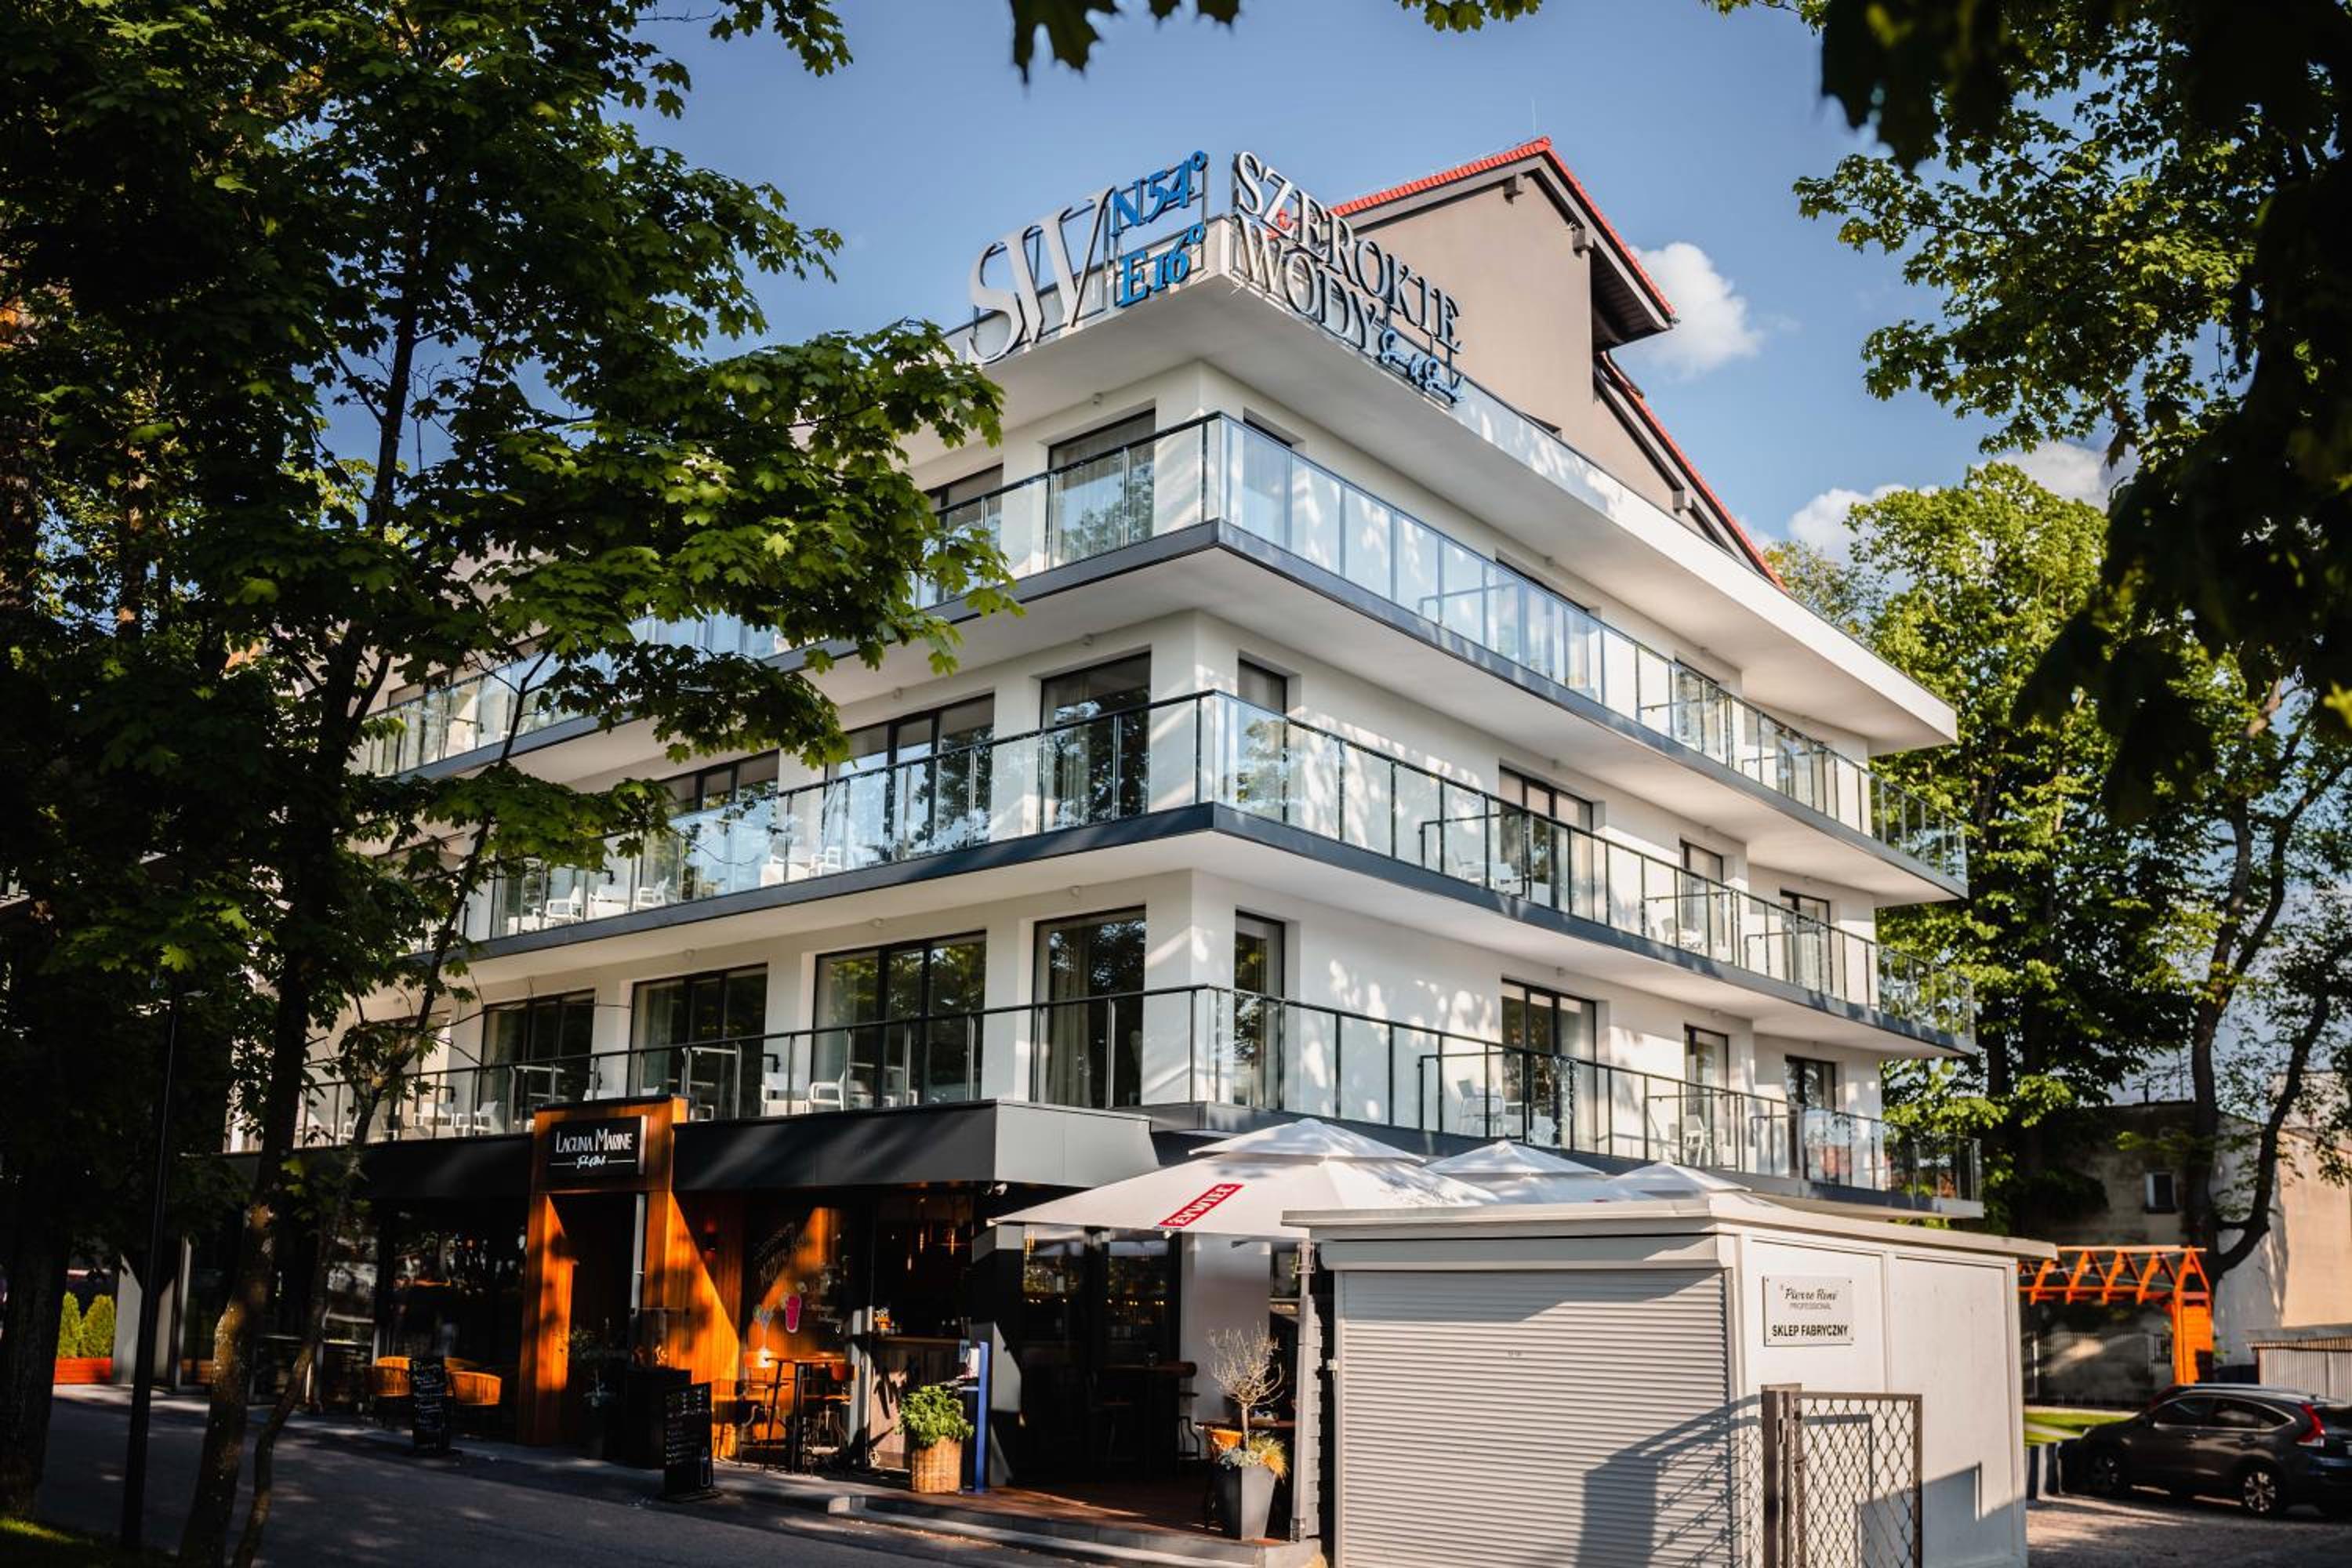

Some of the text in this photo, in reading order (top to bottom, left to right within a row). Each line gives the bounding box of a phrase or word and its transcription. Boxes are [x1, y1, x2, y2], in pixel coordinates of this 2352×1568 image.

[966, 187, 1116, 365] SW
[1232, 212, 1377, 360] WODY
[1233, 151, 1460, 354] SZEROKIE
[1772, 1324, 1848, 1337] SKLEP FABRYCZNY
